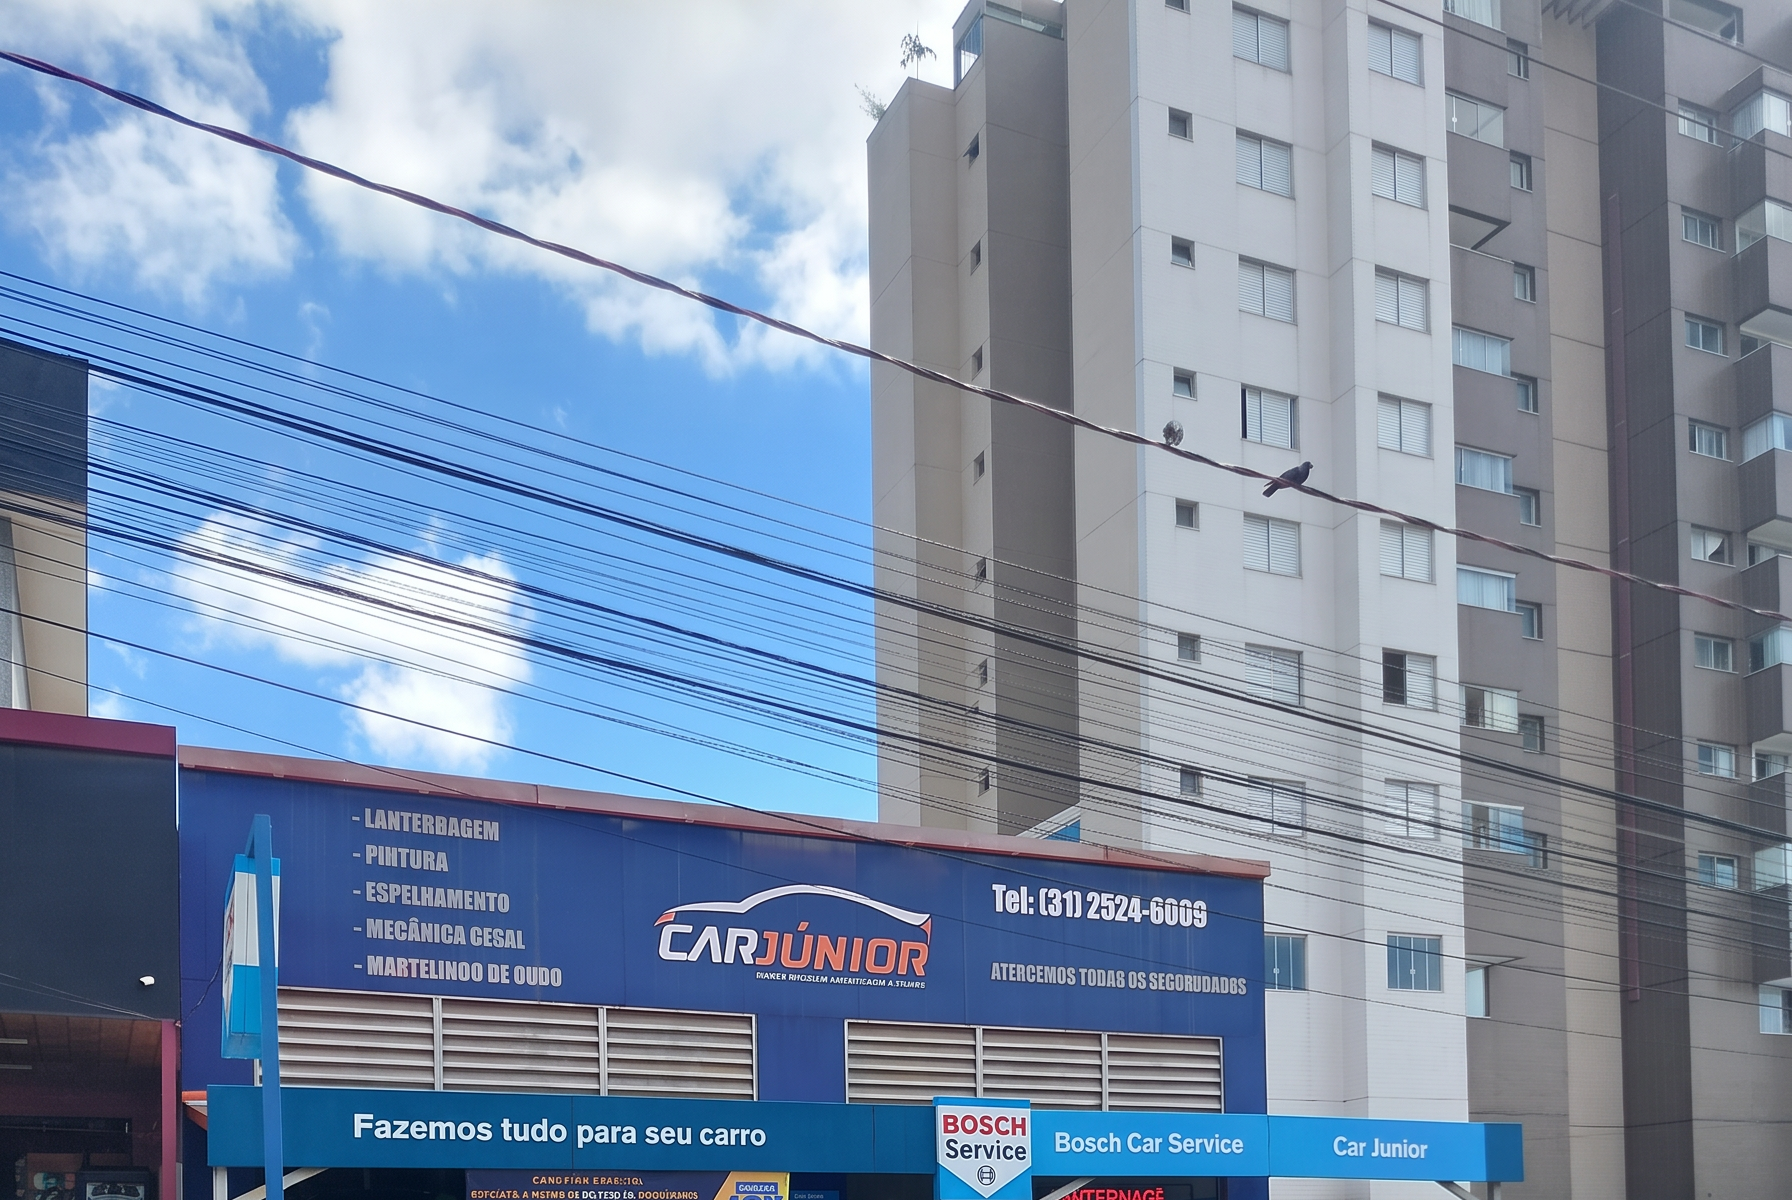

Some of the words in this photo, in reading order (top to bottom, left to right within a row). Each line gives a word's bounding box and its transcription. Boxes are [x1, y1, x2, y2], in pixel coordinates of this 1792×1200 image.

[365, 881, 510, 913] ESPELHAMENTO
[991, 883, 1034, 915] Tel:
[1039, 888, 1082, 919] (31)
[366, 916, 467, 945] MECÂNICA
[487, 963, 510, 984] DE
[1128, 970, 1147, 990] OS
[353, 1113, 493, 1141] Fazemos
[501, 1118, 568, 1143] tudo
[577, 1123, 637, 1149] para
[644, 1127, 692, 1145] seu
[699, 1126, 767, 1147] carro
[942, 1114, 1027, 1137] BOSCH
[945, 1138, 1027, 1161] Service
[1054, 1131, 1121, 1153] Bosch
[1126, 1132, 1162, 1153] Car
[1168, 1132, 1244, 1154] Service
[1333, 1135, 1367, 1157] Car
[1371, 1137, 1428, 1159] Junior
